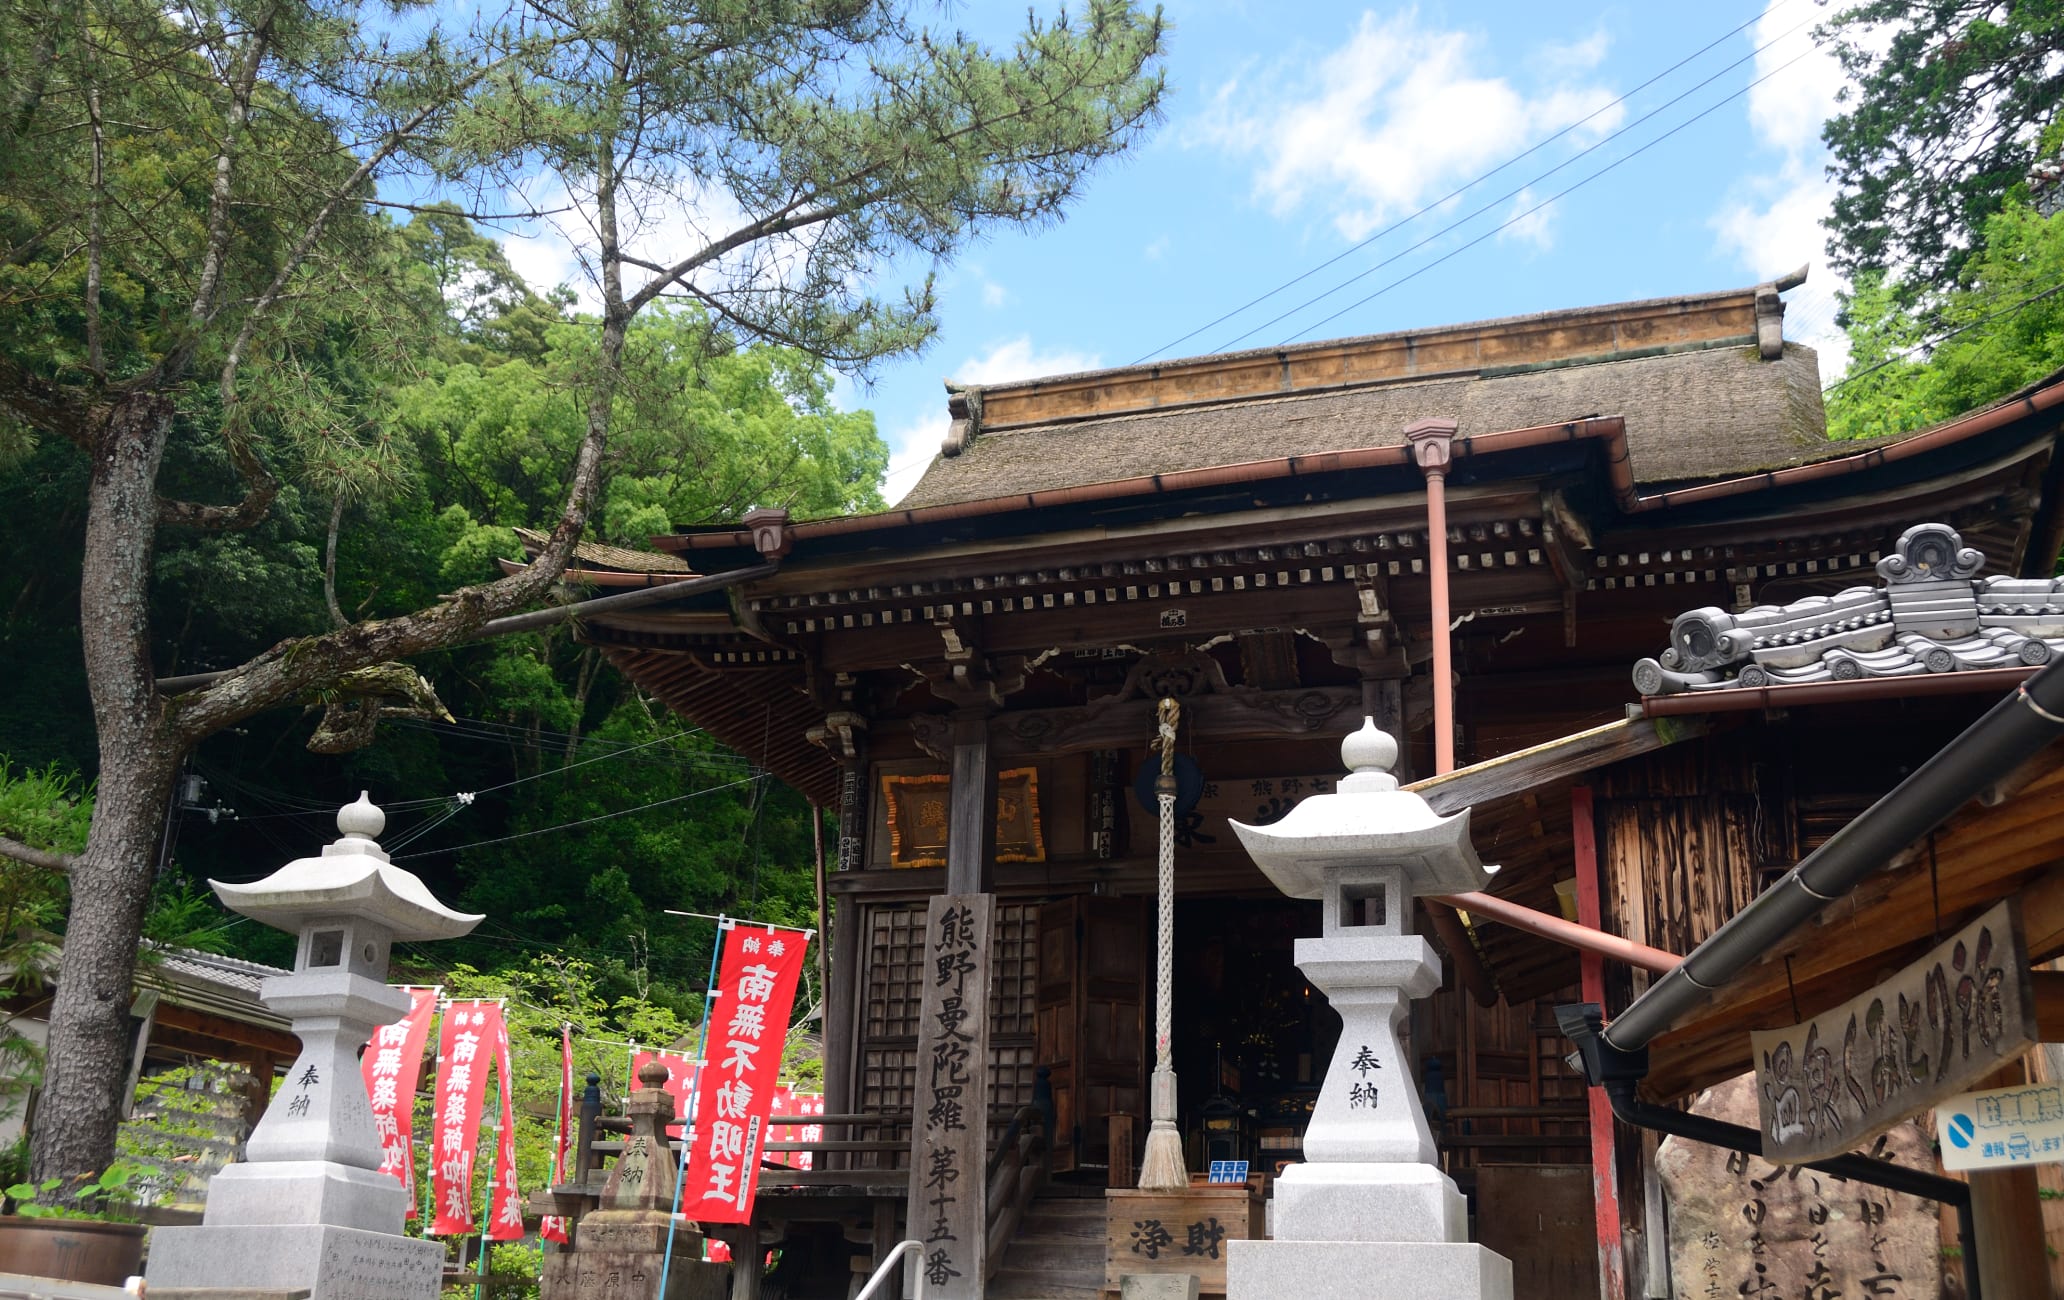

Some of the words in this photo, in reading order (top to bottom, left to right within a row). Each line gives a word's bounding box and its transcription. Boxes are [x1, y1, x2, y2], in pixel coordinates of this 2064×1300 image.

[925, 905, 977, 1132] 熊野曼陀羅
[286, 1064, 321, 1118] 奉納
[1349, 1044, 1382, 1110] 奉納
[621, 1136, 649, 1184] 奉納
[923, 1149, 962, 1287] 第十五番
[1130, 1217, 1225, 1260] 浄財
